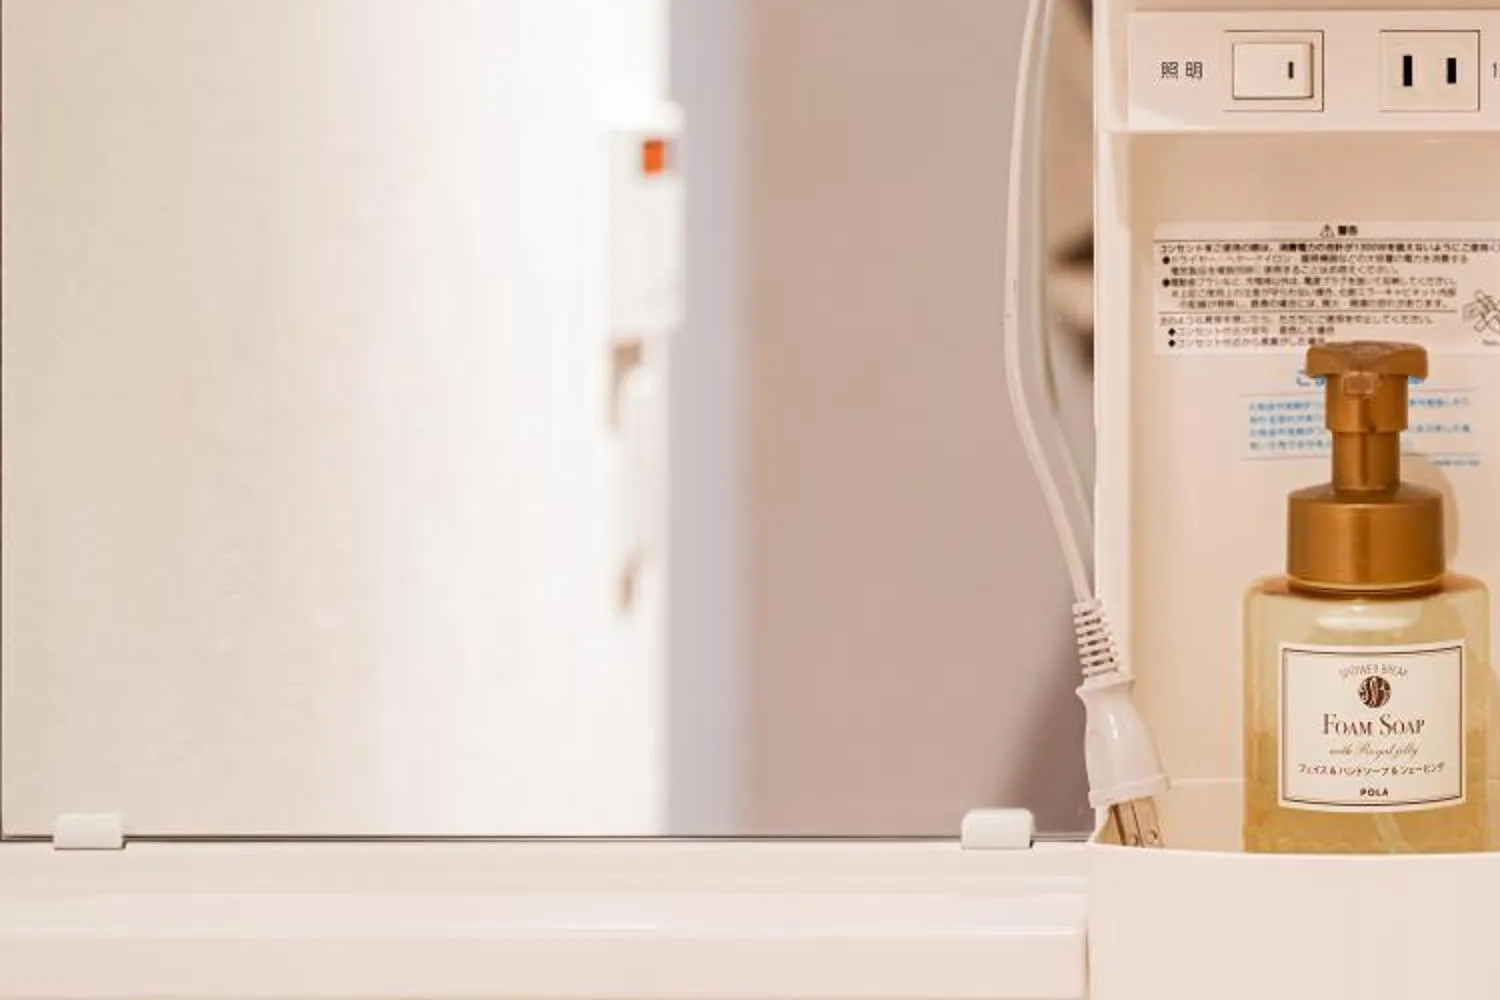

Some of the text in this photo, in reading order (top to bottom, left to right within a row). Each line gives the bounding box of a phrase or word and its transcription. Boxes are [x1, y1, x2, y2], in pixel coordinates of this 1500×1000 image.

[1323, 713, 1425, 736] FOAM SOAP
[1360, 788, 1389, 797] POLA
